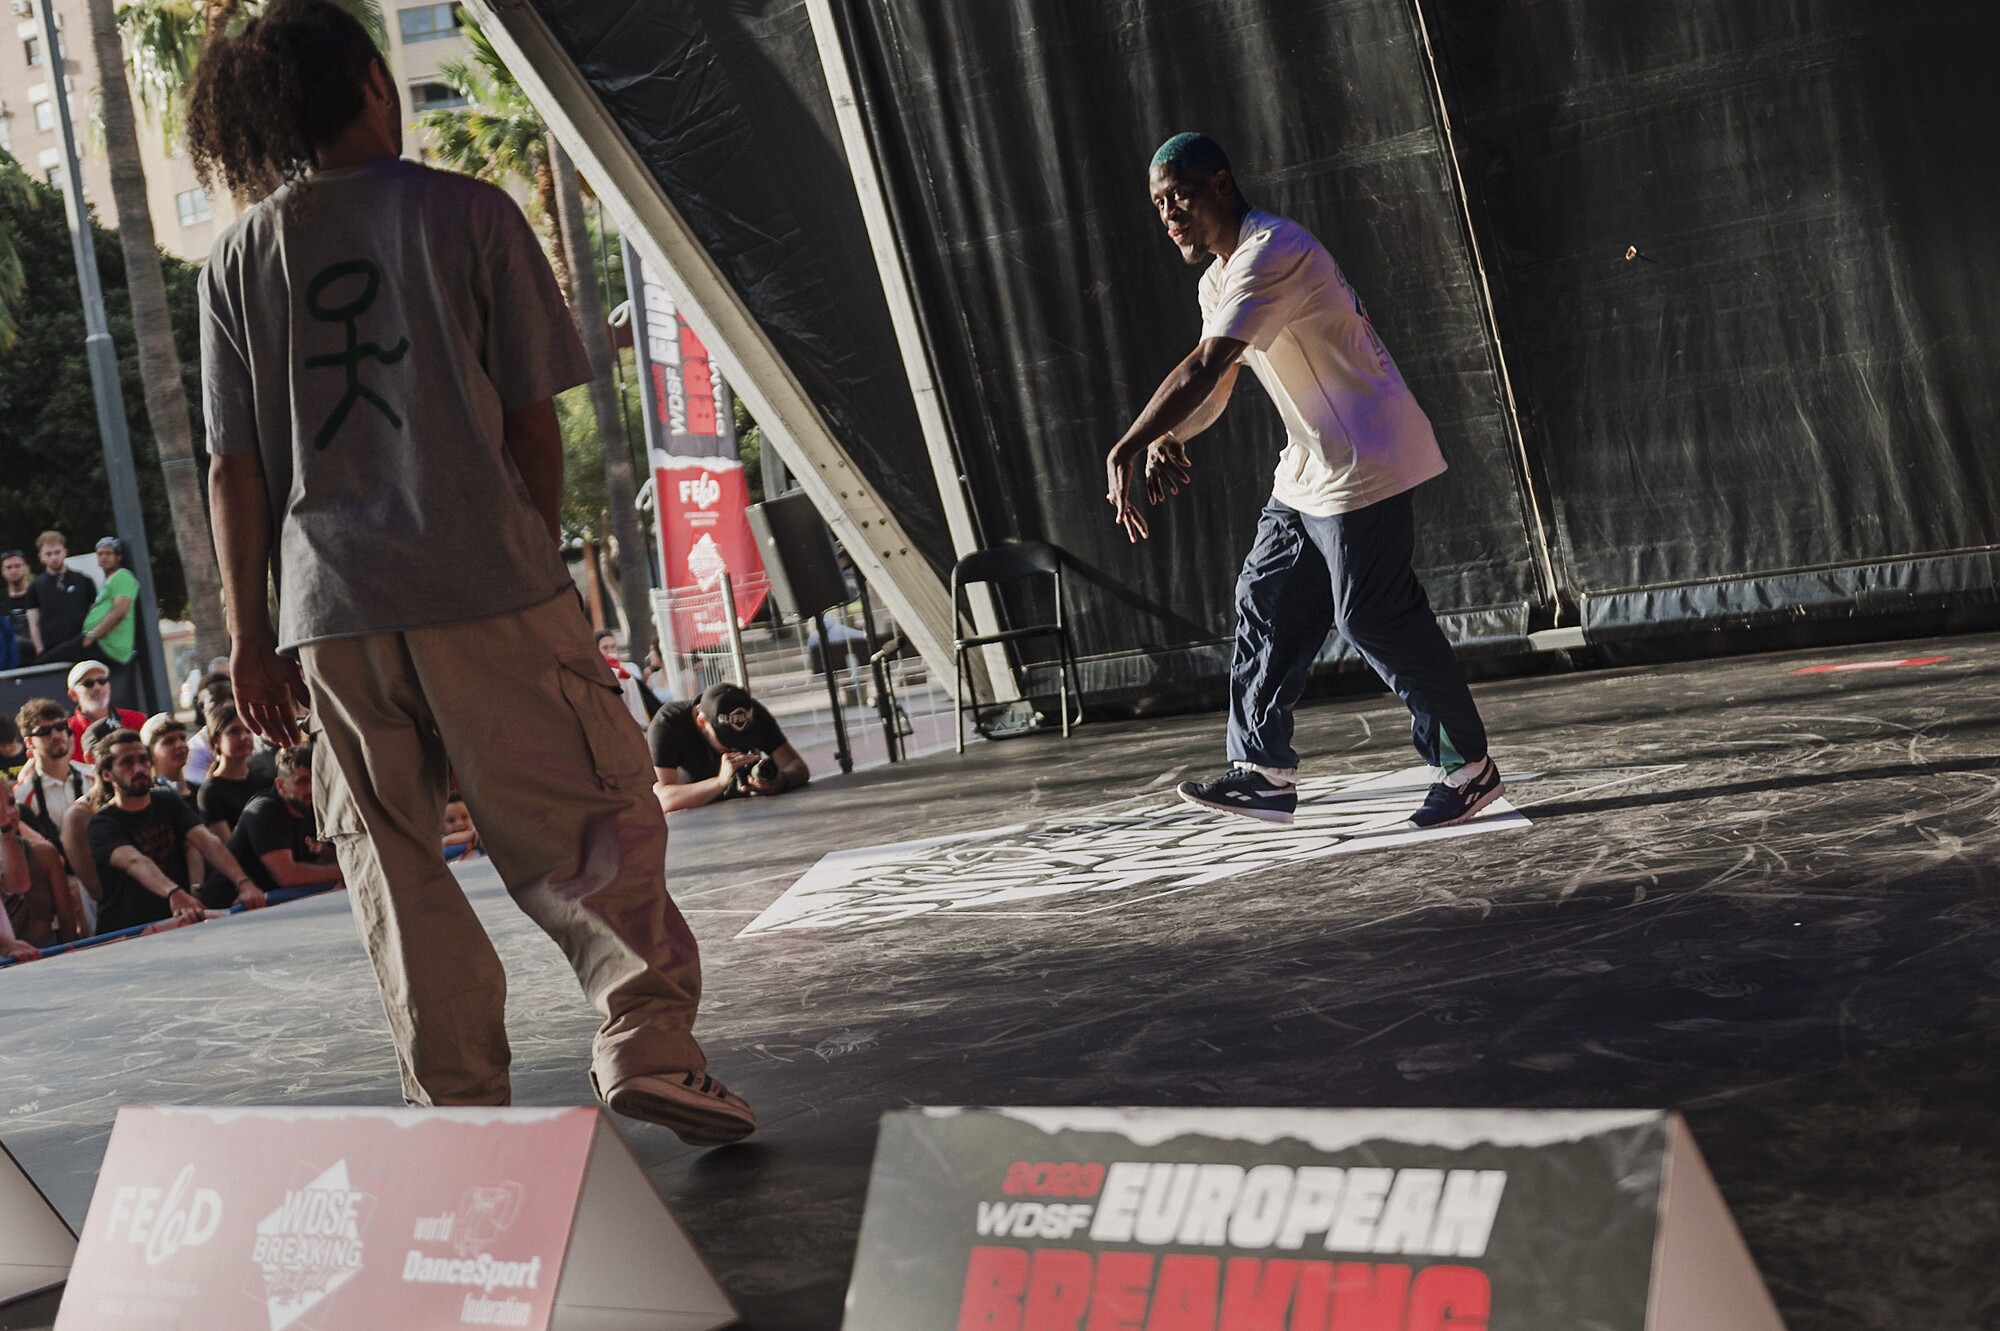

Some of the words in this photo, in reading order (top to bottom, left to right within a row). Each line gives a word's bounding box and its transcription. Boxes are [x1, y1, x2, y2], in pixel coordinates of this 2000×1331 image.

[666, 366, 688, 436] WDSF
[677, 310, 717, 435] BRE
[976, 1201, 1094, 1240] WDSF
[1089, 1161, 1508, 1258] EUROPEAN
[1001, 1161, 1107, 1198] 2023
[276, 1188, 364, 1239] WDSF
[252, 1233, 365, 1269] BREAKING
[402, 1249, 542, 1293] DanceSport
[957, 1245, 1492, 1331] BREAKING
